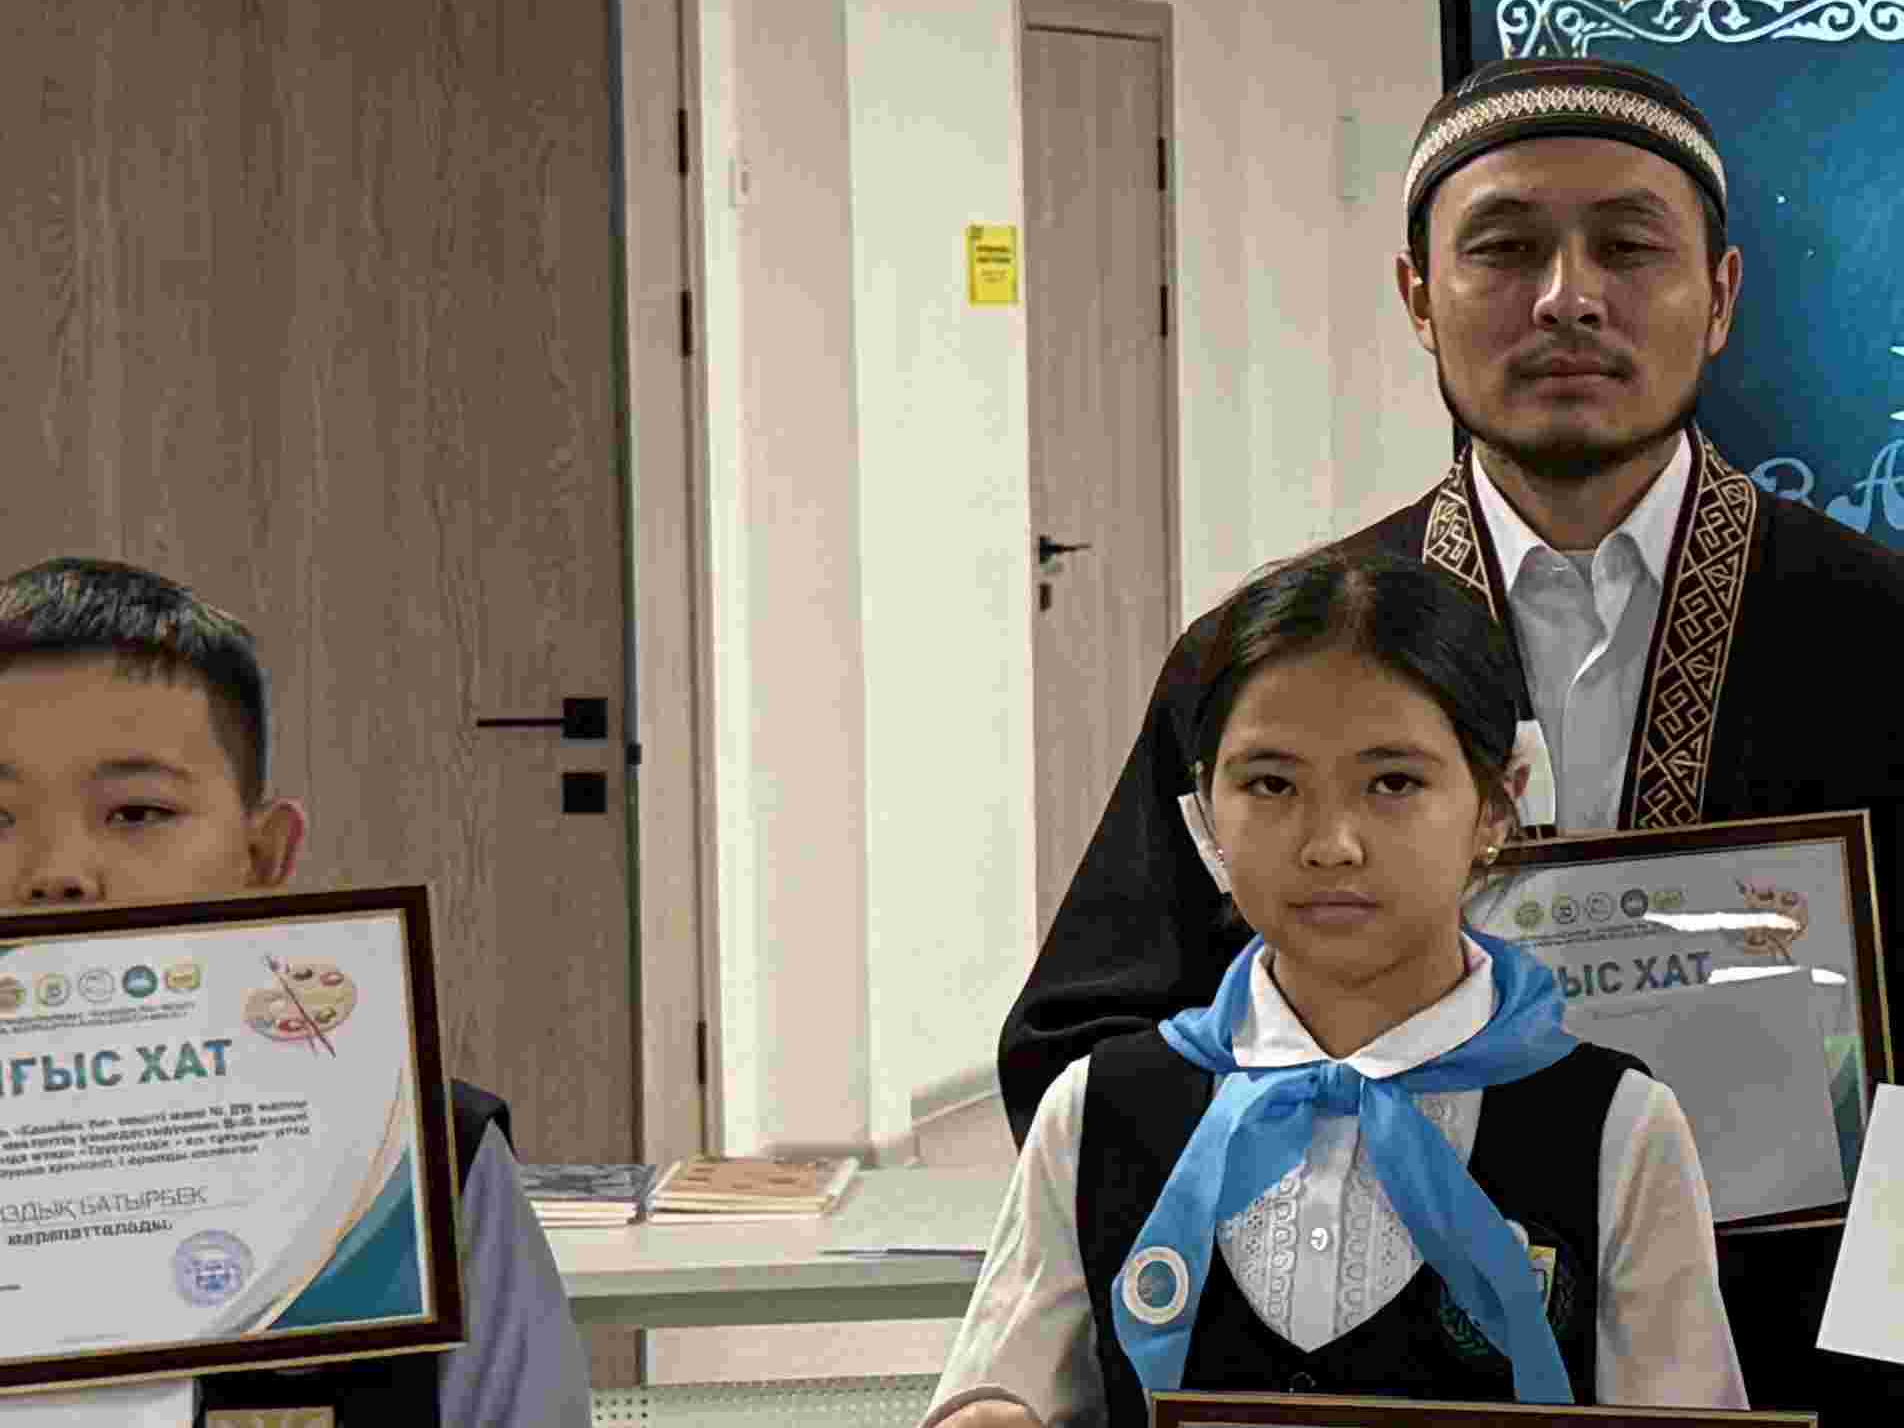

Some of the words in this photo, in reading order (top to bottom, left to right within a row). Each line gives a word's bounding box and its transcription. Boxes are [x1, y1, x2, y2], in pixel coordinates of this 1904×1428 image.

[1633, 950, 1713, 992] ХАТ
[0, 1049, 121, 1098] ҒЫС
[136, 1039, 232, 1084] ХАТ
